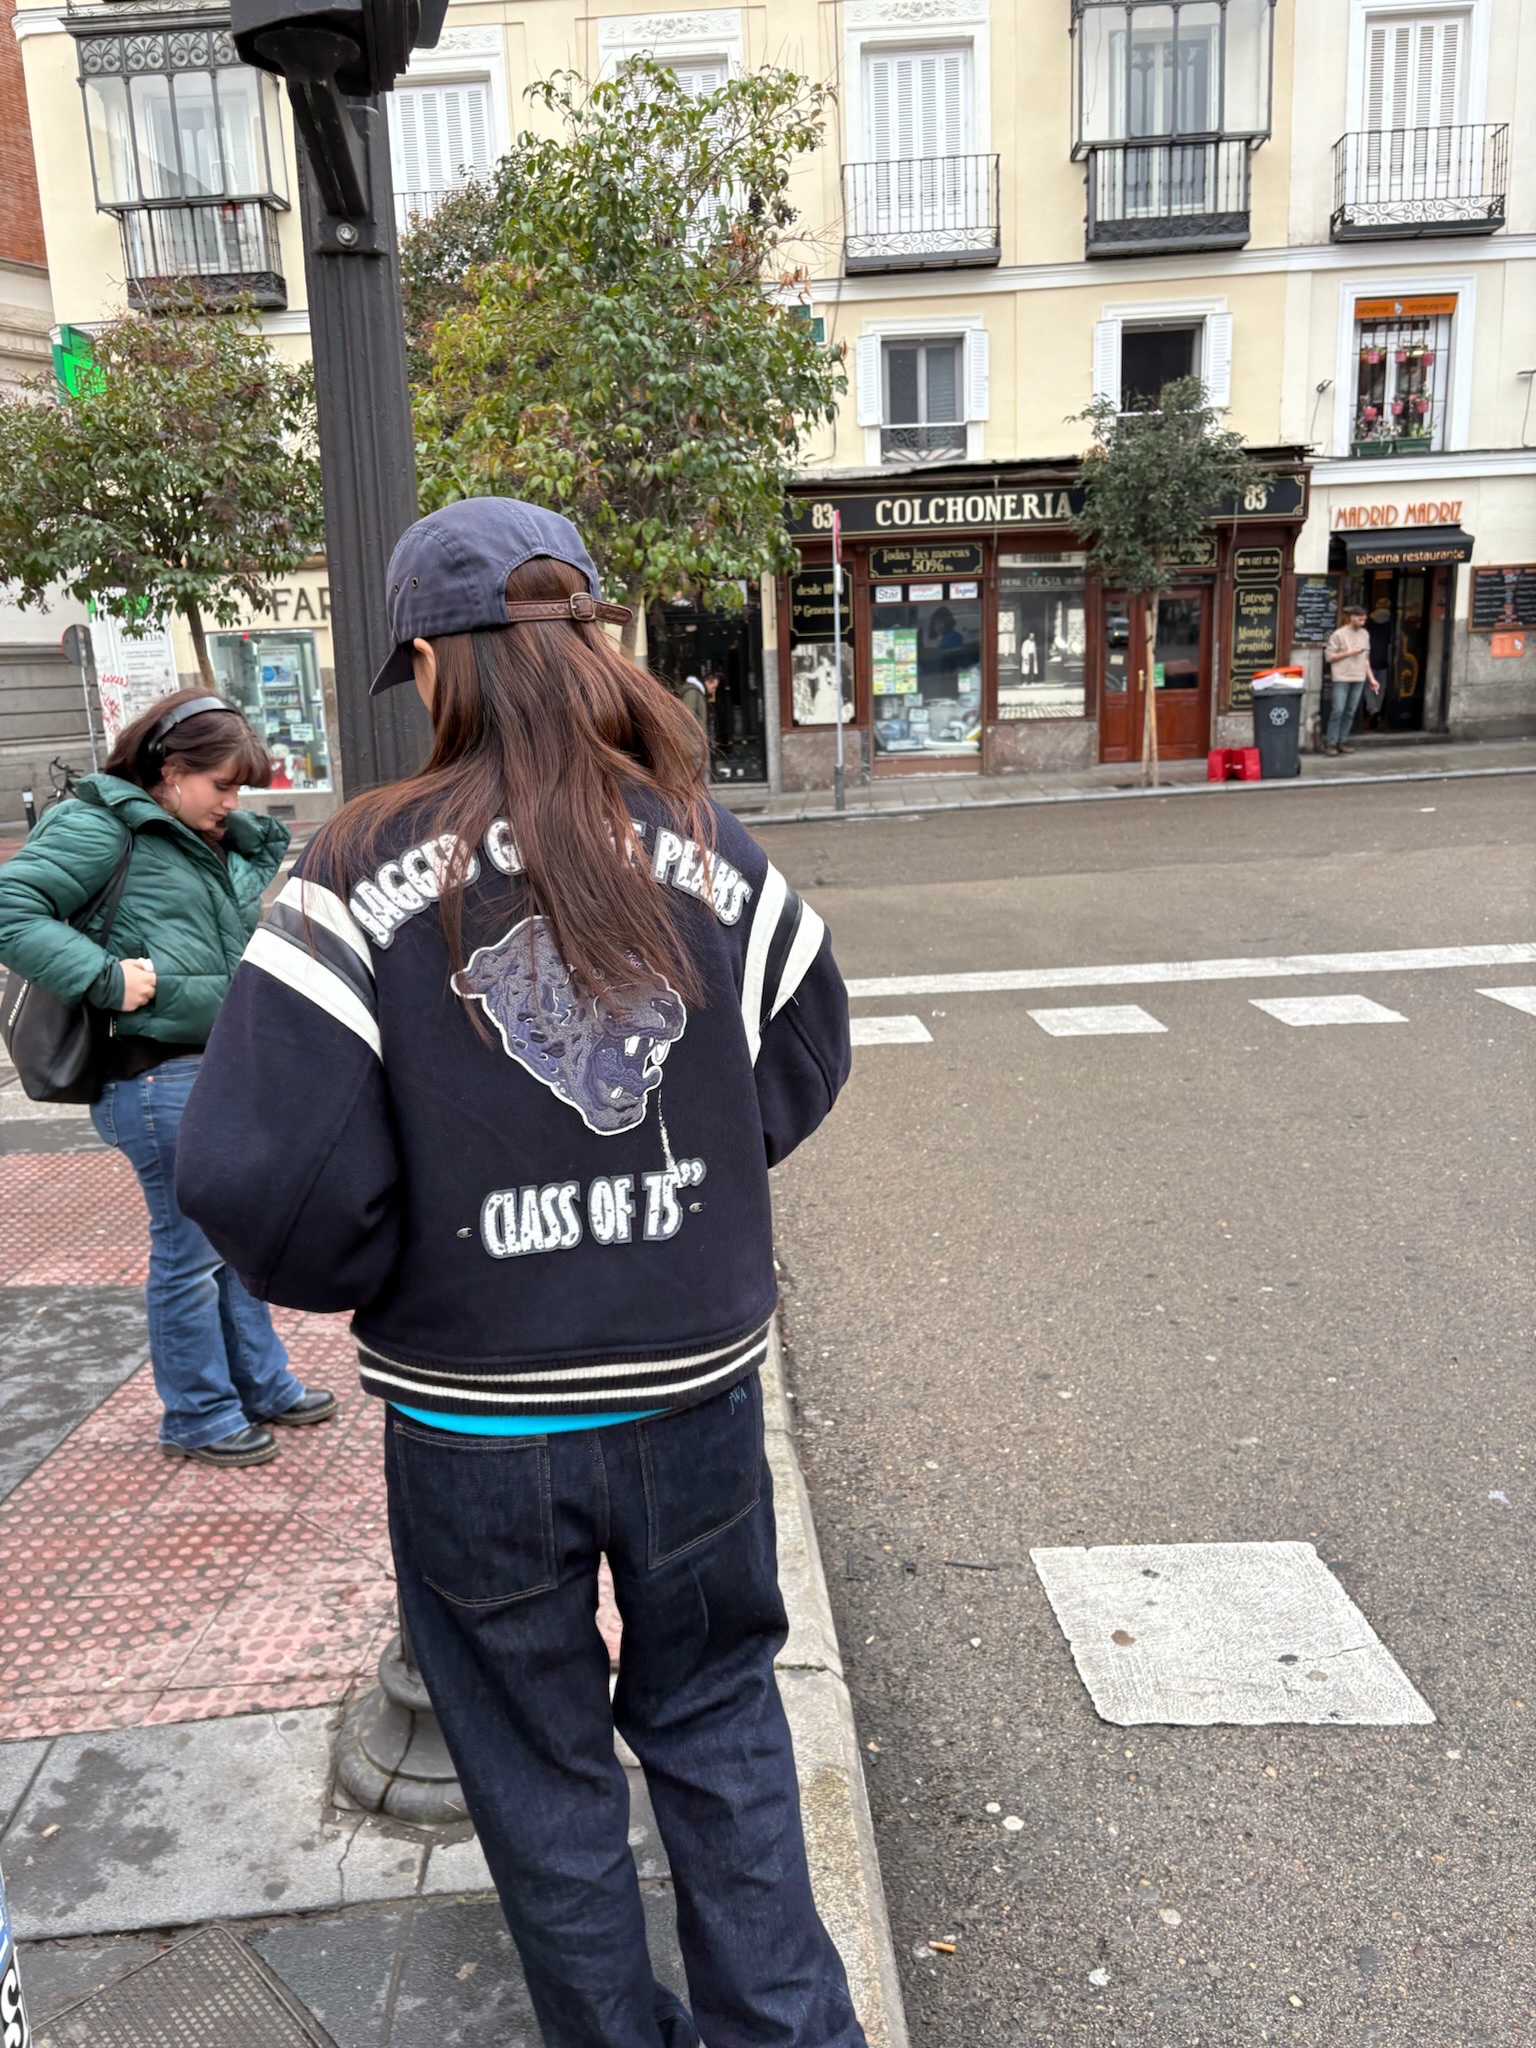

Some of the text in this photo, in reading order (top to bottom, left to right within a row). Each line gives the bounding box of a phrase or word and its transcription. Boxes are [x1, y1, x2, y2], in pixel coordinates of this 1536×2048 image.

[811, 492, 1074, 529] 83 COLCHONERIA
[1335, 500, 1463, 529] MADRID MADRIZ
[911, 559, 945, 573] 50%
[1355, 549, 1466, 566] taberna restaurante
[654, 827, 753, 926] PEAKS
[480, 1181, 582, 1259] CLASS
[589, 1175, 636, 1245] OF
